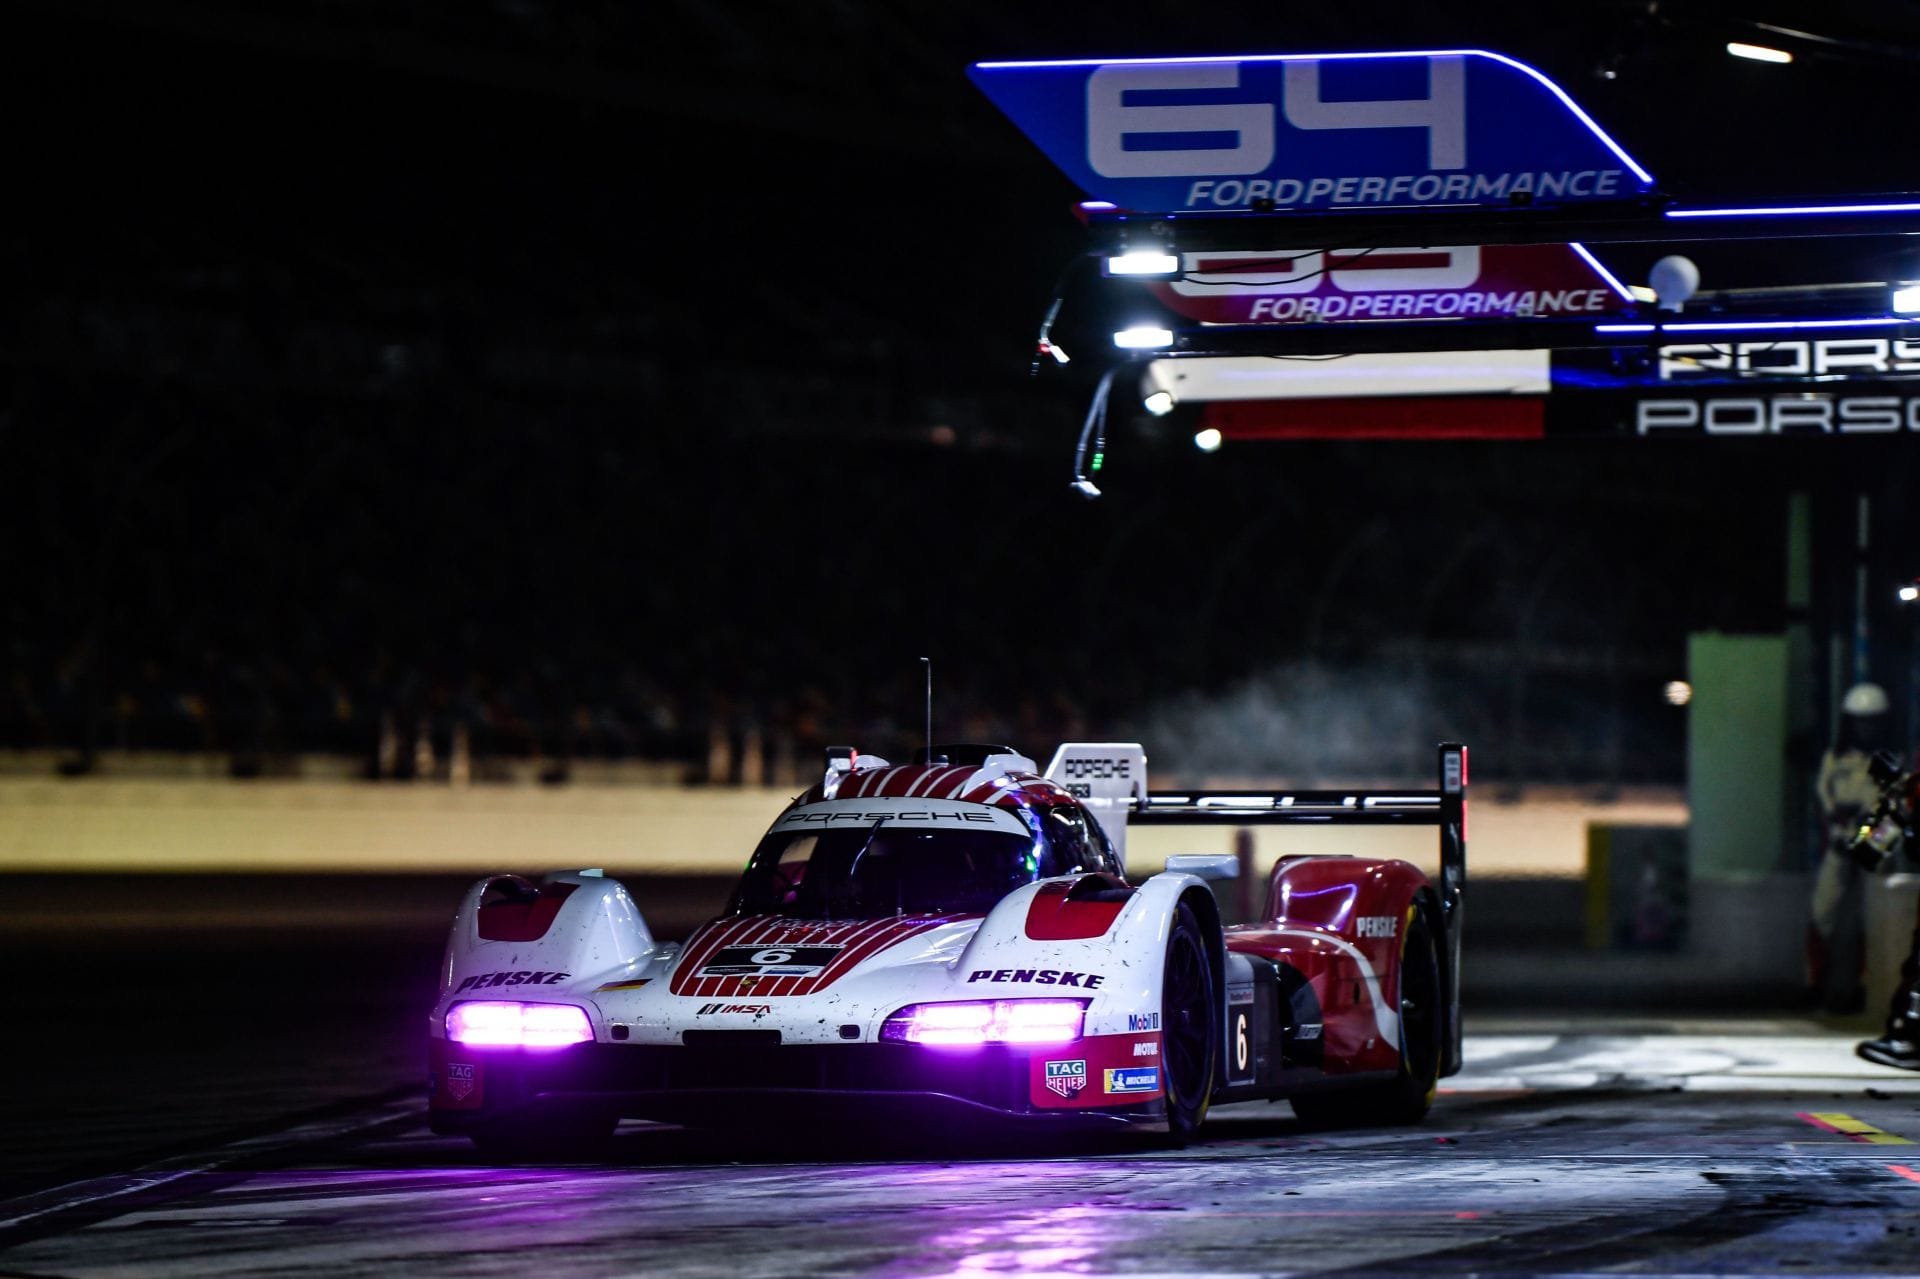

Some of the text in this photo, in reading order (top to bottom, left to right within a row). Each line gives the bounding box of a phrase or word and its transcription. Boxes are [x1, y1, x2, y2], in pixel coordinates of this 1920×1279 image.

[1087, 55, 1466, 179] 64
[1637, 396, 1920, 435] PORS
[1065, 758, 1130, 779] PORSCHE
[783, 811, 996, 825] PORSCHE
[1356, 916, 1398, 938] PENSKE
[750, 948, 797, 964] 6
[454, 970, 572, 995] PENSKE
[967, 969, 1106, 990] PENSKE
[720, 1004, 771, 1014] IMSA
[1128, 1013, 1152, 1031] Mobil
[1133, 1042, 1158, 1056] MOTUL
[1236, 1013, 1247, 1070] 6
[450, 1065, 472, 1078] TAG
[1048, 1062, 1083, 1075] TAG
